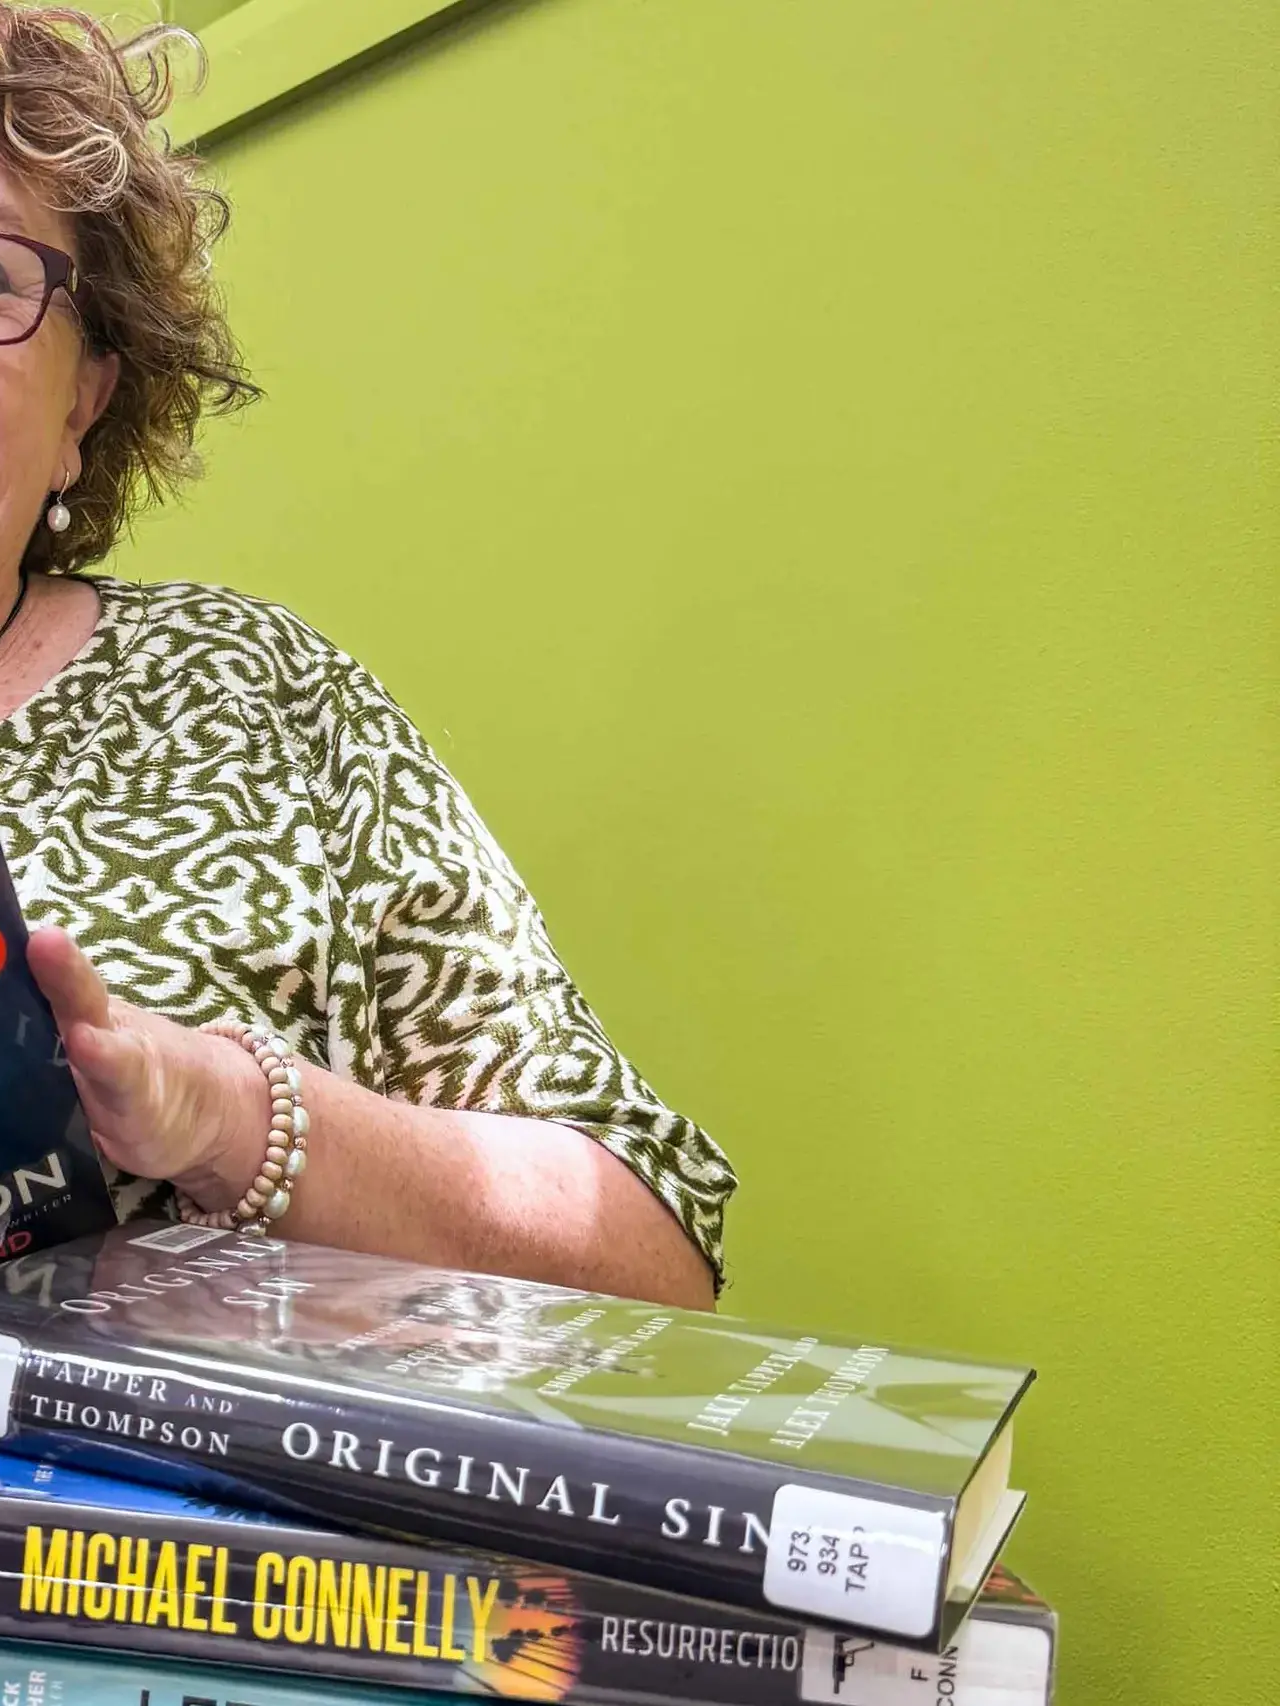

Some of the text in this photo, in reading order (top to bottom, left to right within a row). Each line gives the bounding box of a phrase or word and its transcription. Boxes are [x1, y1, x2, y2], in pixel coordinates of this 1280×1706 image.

[60, 1236, 287, 1315] ORIGINAL
[223, 1276, 316, 1310] SIN
[32, 1358, 234, 1416] TAPPER AND
[686, 1393, 752, 1437] JAKE
[726, 1351, 804, 1395] TAPPER
[768, 1343, 891, 1451] ALEX THOMPSON
[29, 1393, 232, 1457] THOMPSON
[281, 1420, 772, 1555] ORIGINAL SIN
[816, 1533, 841, 1576] 934
[19, 1525, 500, 1665] MICHAEL CONNELLY
[600, 1615, 799, 1672] RESURRECTIO
[909, 1666, 929, 1682] F
